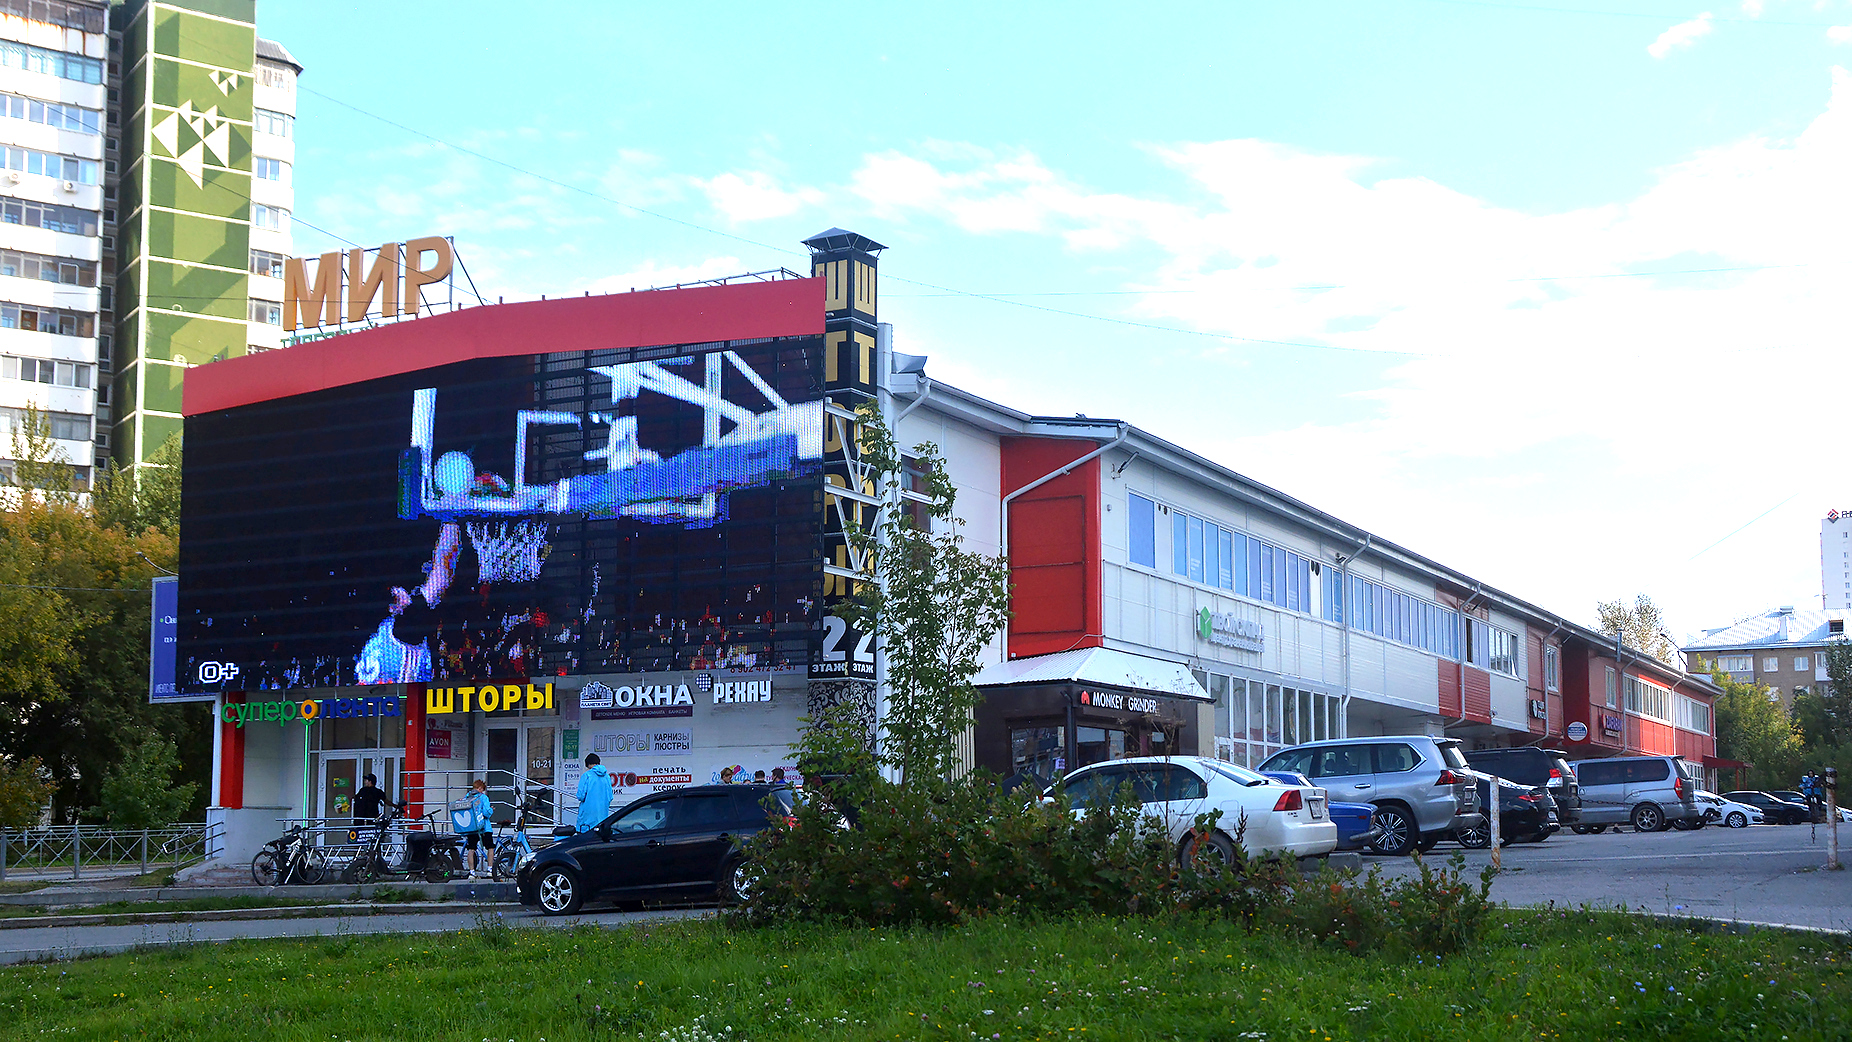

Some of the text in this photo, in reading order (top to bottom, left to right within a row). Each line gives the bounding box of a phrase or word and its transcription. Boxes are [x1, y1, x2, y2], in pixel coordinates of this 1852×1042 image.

[283, 236, 455, 332] МИР
[823, 615, 847, 662] 2
[199, 661, 239, 684] 0+
[812, 663, 846, 673] ЭТАЖ
[852, 662, 874, 674] ЭТАЖ
[426, 683, 553, 714] ШТОРЫ
[615, 684, 694, 707] ОКНА
[713, 680, 772, 704] РЕХАУ
[1092, 691, 1157, 713] MONKEY GRINDER
[221, 696, 402, 728] супер лента
[430, 737, 449, 746] AVON
[594, 733, 650, 752] ШТОРЫ
[654, 733, 690, 741] КАРНИЗЫ
[654, 742, 690, 751] ЛЮСТРЫ
[531, 759, 552, 769] 10-21
[652, 766, 686, 774] печать
[649, 775, 690, 784] документы
